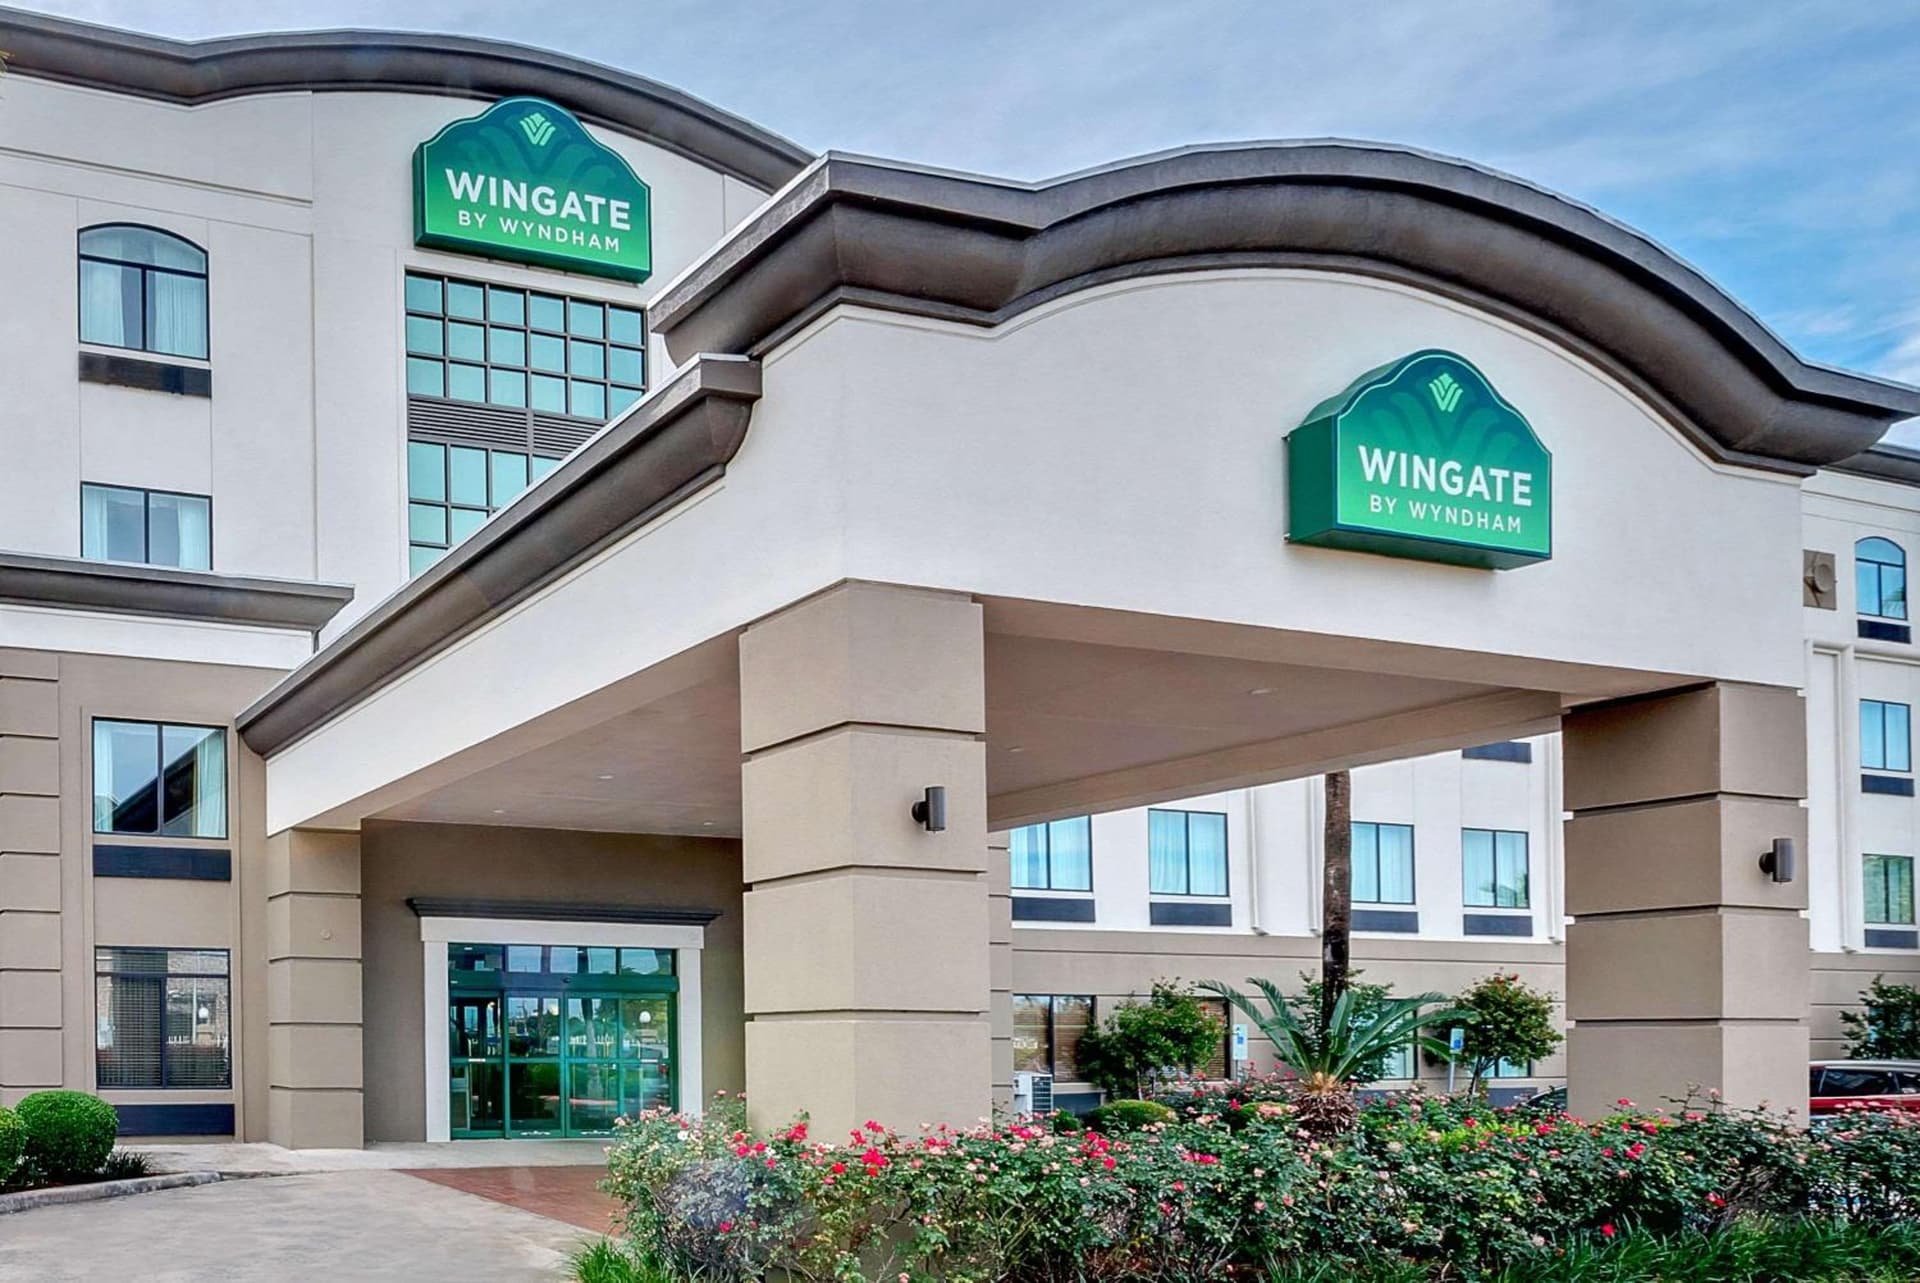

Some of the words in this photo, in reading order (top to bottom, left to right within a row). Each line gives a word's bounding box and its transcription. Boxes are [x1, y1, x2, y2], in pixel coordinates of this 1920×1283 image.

[445, 168, 631, 231] WINGATE
[458, 210, 487, 229] BY
[499, 217, 620, 253] WYNDHAM
[1358, 444, 1532, 507] WINGATE
[1370, 494, 1397, 515] BY
[1408, 500, 1521, 534] WYNDHAM
